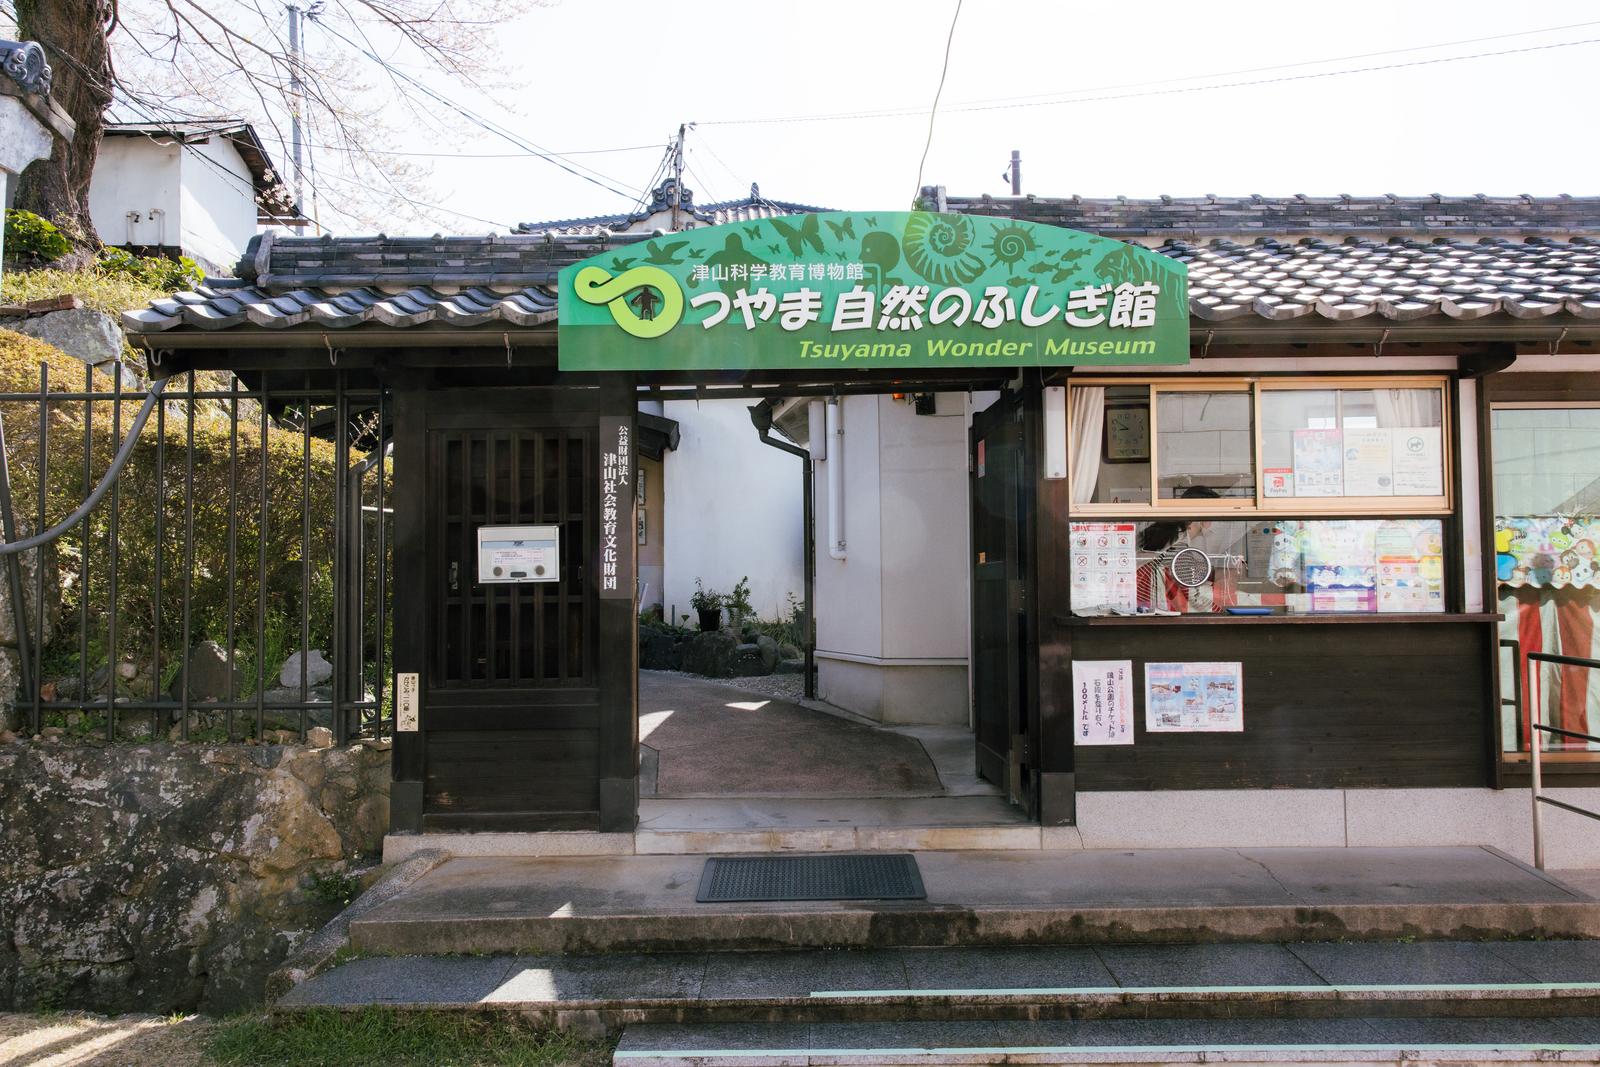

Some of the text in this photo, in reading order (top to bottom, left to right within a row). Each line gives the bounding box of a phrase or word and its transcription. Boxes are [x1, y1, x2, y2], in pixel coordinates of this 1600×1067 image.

[691, 263, 864, 282] 津山科学教育博物館
[689, 280, 1160, 332] つやま自然のふしぎ館
[800, 338, 1157, 360] Tsuyama Wonder Museum
[618, 425, 629, 486] 公益財団法人
[603, 452, 617, 590] 津山社会教育文化財団
